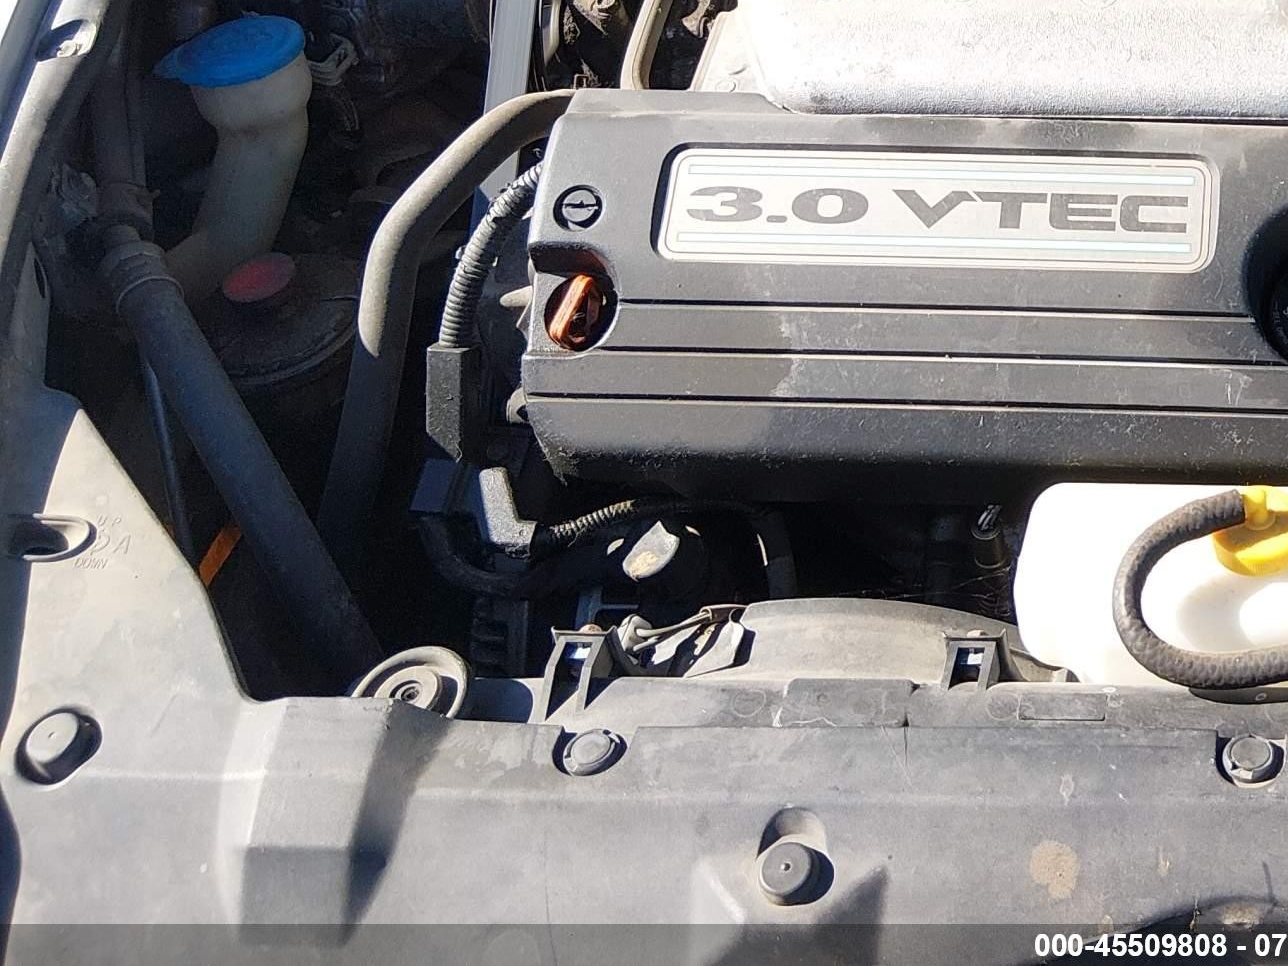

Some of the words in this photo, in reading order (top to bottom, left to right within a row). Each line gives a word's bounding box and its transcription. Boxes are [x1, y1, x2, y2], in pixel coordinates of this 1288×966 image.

[687, 185, 869, 224] 3.0
[892, 188, 1189, 234] VTEC
[72, 557, 110, 571] DOWN
